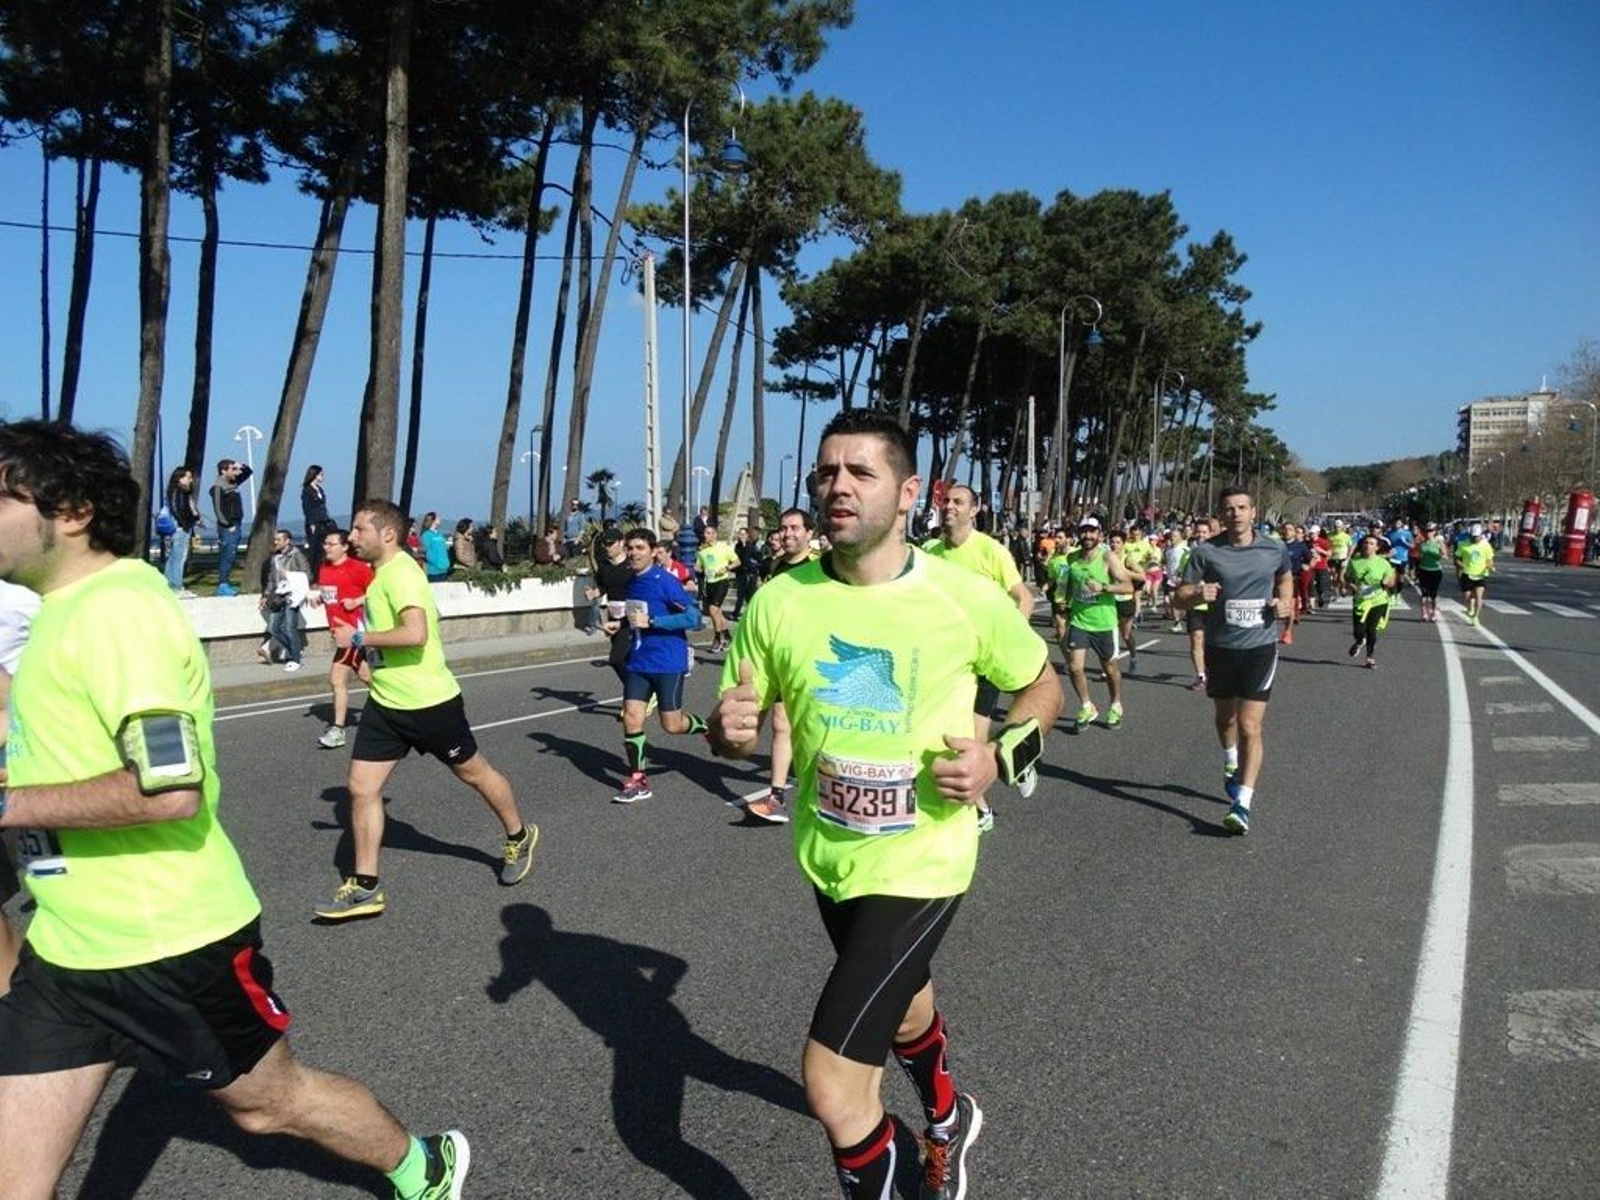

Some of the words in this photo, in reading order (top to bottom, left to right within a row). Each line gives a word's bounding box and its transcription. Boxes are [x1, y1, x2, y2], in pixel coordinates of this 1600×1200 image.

[820, 714, 899, 734] VIG-BAY
[841, 763, 894, 778] VIG-BAY
[831, 781, 897, 817] 5239
